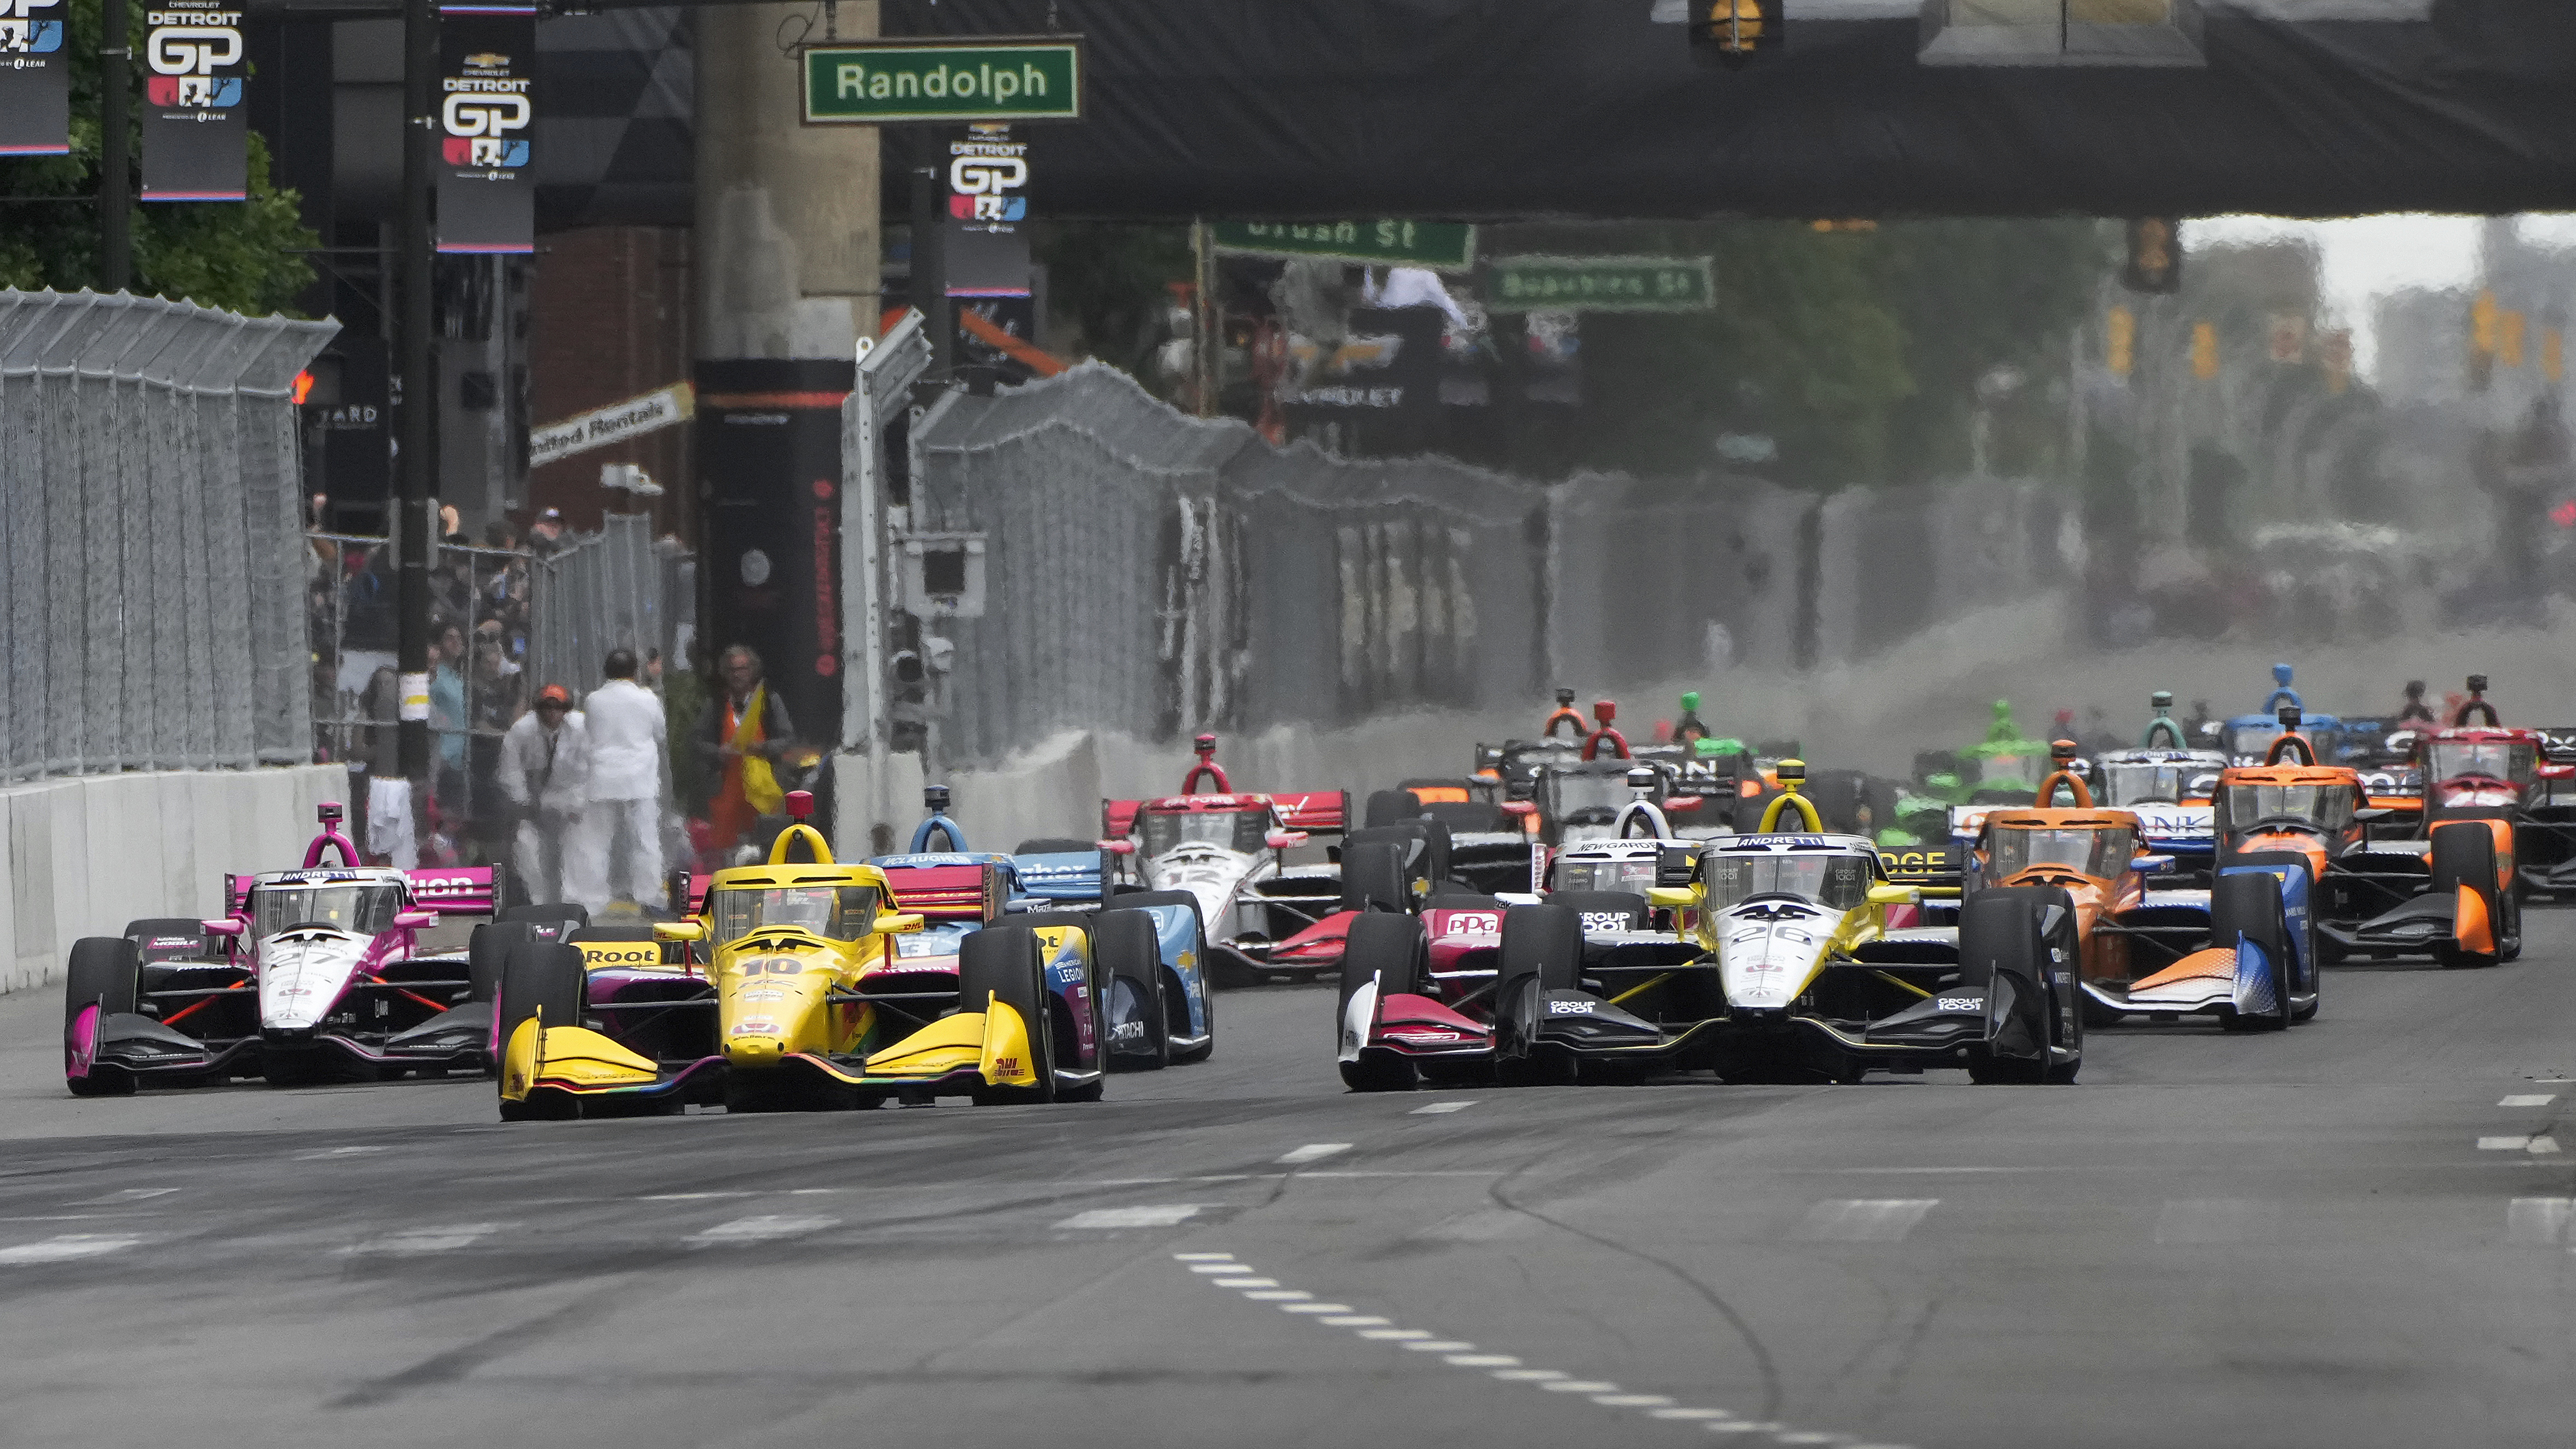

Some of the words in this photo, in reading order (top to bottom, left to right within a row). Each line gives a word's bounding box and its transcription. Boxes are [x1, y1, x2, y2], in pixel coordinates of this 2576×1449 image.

[148, 12, 242, 25] DETROIT
[148, 27, 242, 74] GP
[443, 78, 529, 91] DETROIT
[837, 62, 1047, 105] Randolph
[443, 93, 530, 136] GP
[950, 143, 1027, 156] DETROIT
[950, 157, 1027, 194] GP
[1738, 836, 1823, 846] ANDRETTI
[281, 870, 355, 881] ANDRETTI
[1580, 913, 1630, 921] ROUP
[903, 922, 922, 931] DHL
[1450, 916, 1496, 934] PPG
[1730, 926, 1814, 946] 26
[586, 950, 655, 963] Root
[741, 959, 803, 977] 10
[1058, 966, 1085, 983] LEGION
